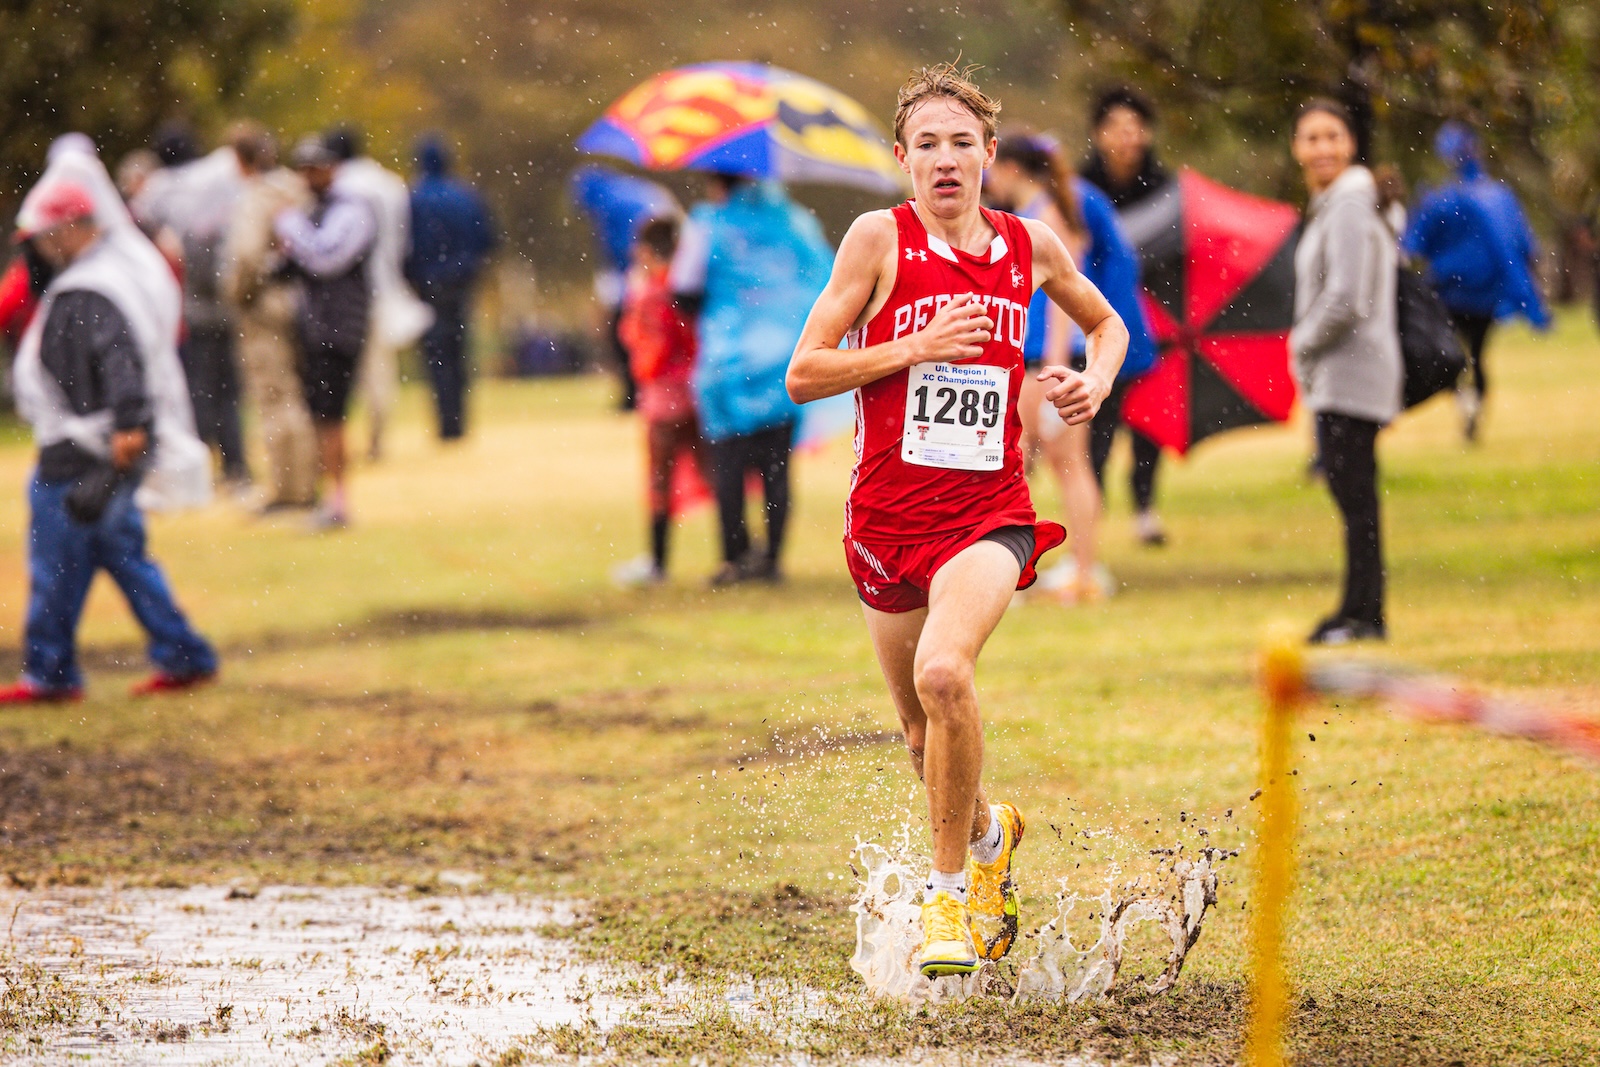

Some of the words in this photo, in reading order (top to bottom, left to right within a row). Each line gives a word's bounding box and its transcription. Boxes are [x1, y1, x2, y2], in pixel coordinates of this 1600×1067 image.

[893, 294, 1027, 352] PEYTO
[935, 365, 949, 373] UIL
[951, 367, 982, 376] Region
[922, 373, 935, 382] XC
[937, 375, 996, 387] Championship
[912, 385, 1000, 428] 1289
[985, 454, 999, 462] 1289
